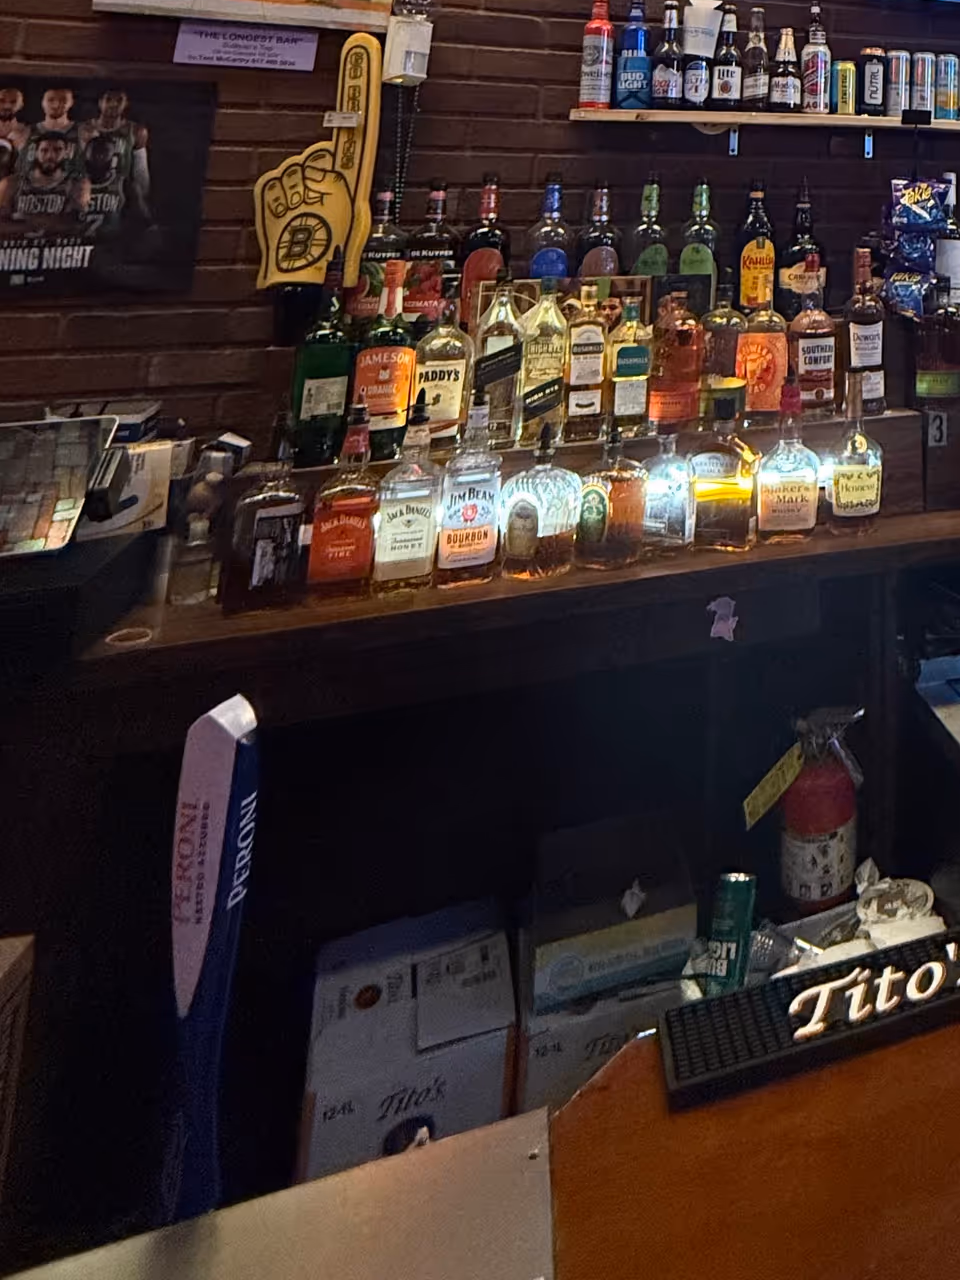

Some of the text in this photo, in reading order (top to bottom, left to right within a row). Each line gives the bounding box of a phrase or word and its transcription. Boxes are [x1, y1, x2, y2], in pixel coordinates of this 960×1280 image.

[620, 71, 645, 81] BUD
[717, 68, 736, 79] Lite
[617, 79, 648, 90] LIGHT
[42, 245, 95, 269] NIGHT
[360, 352, 411, 368] JAMESON
[418, 368, 460, 383] PADDY'S
[932, 414, 944, 444] 3
[447, 487, 495, 509] JIM BEAM
[776, 493, 809, 504] Mark
[387, 509, 404, 523] JACK
[446, 529, 488, 544] BOURBON
[390, 543, 423, 552] HONEY
[226, 790, 258, 912] PERONI
